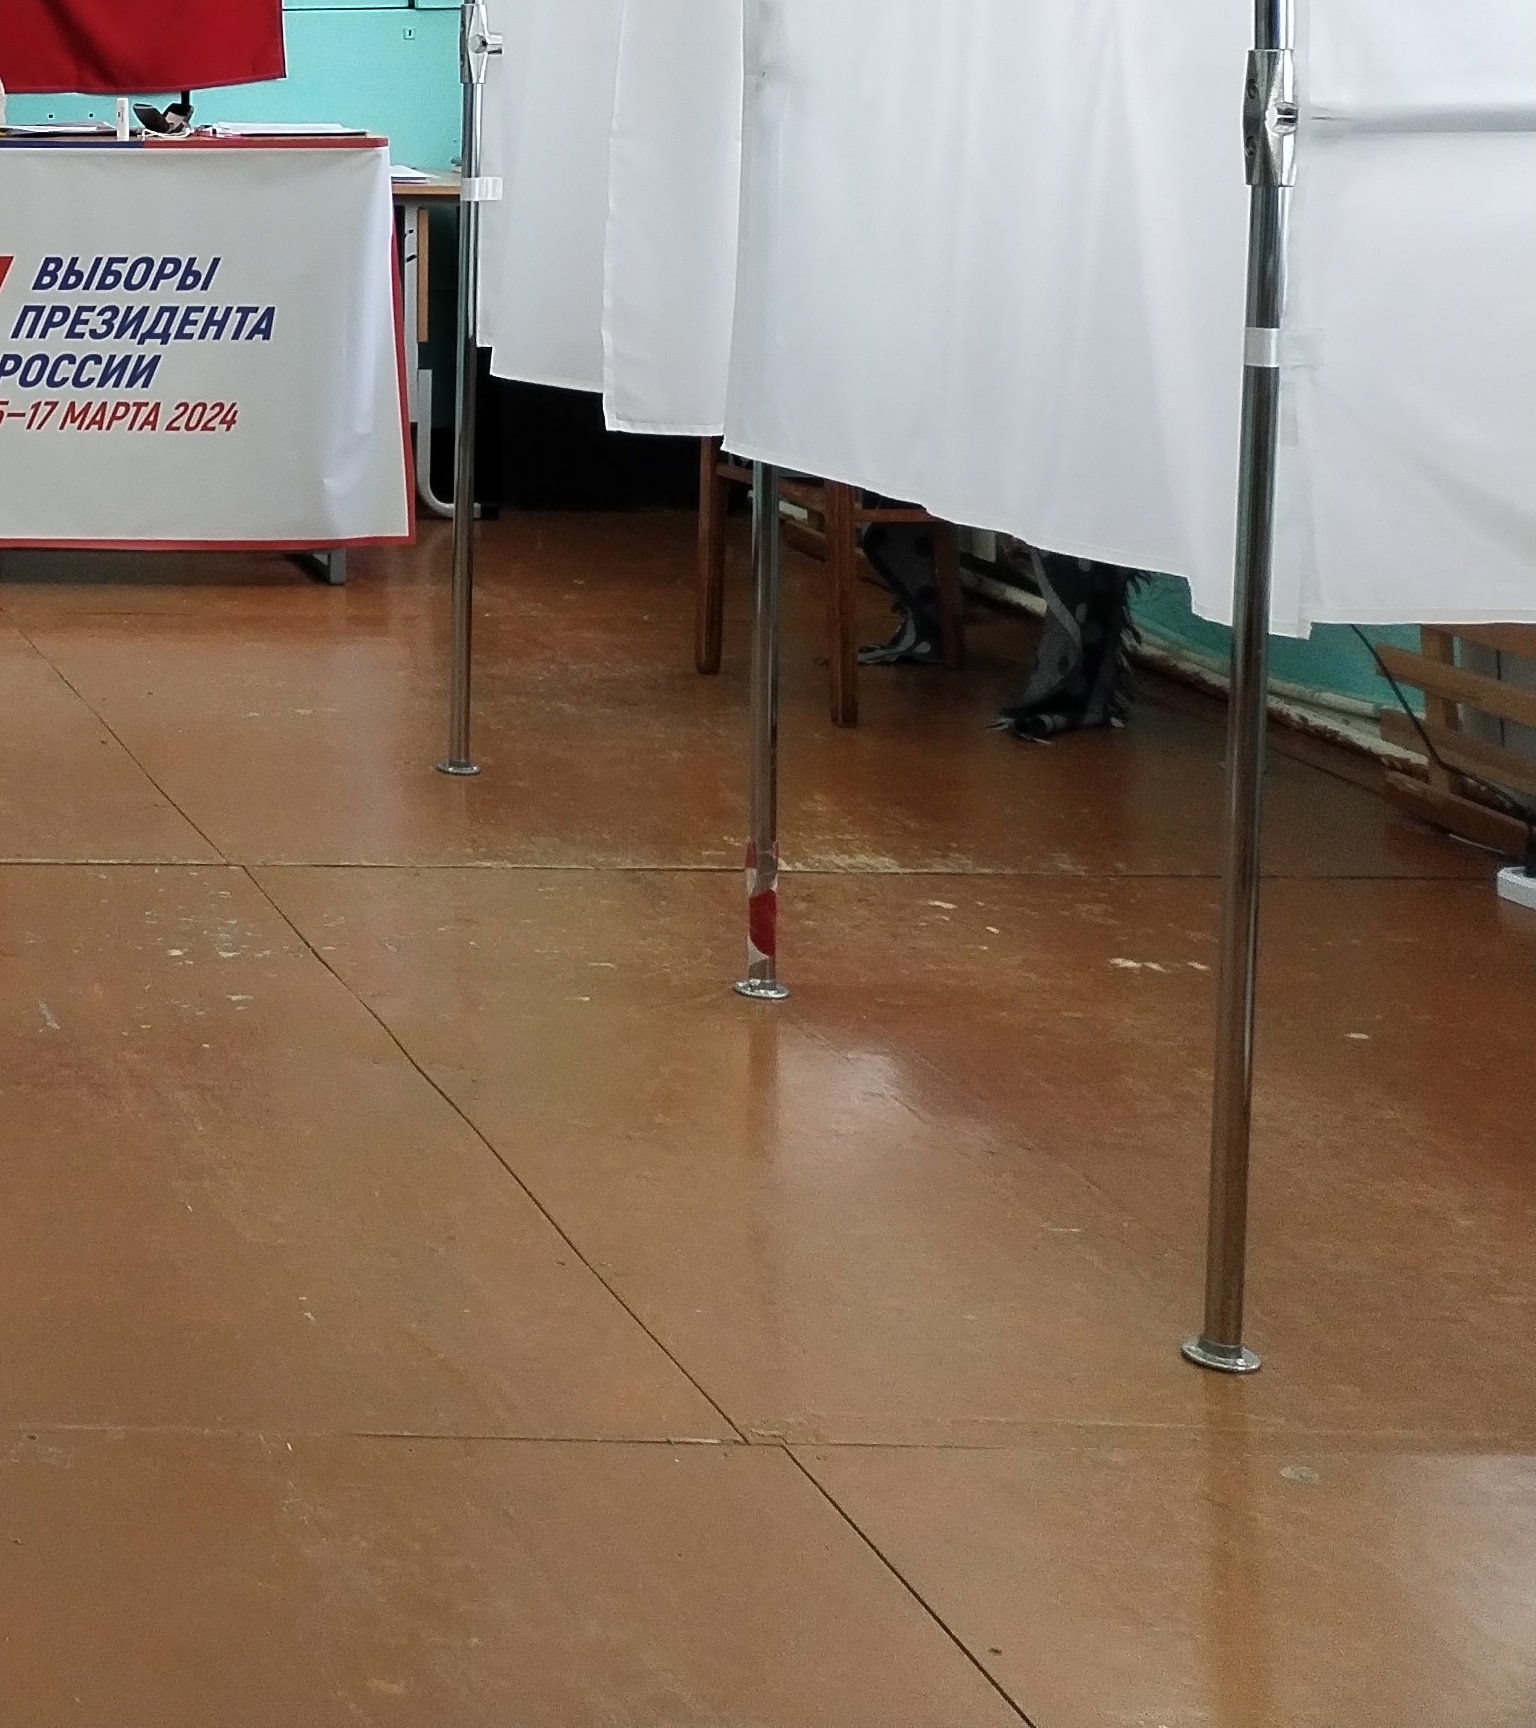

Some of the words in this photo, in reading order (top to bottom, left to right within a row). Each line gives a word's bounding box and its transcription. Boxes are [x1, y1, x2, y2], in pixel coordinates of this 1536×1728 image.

[31, 256, 221, 292] ВЫБОРЫ
[10, 305, 275, 347] ПРЕЗИДЕНТА
[60, 401, 161, 433] МАРТА
[165, 401, 240, 433] 2024
